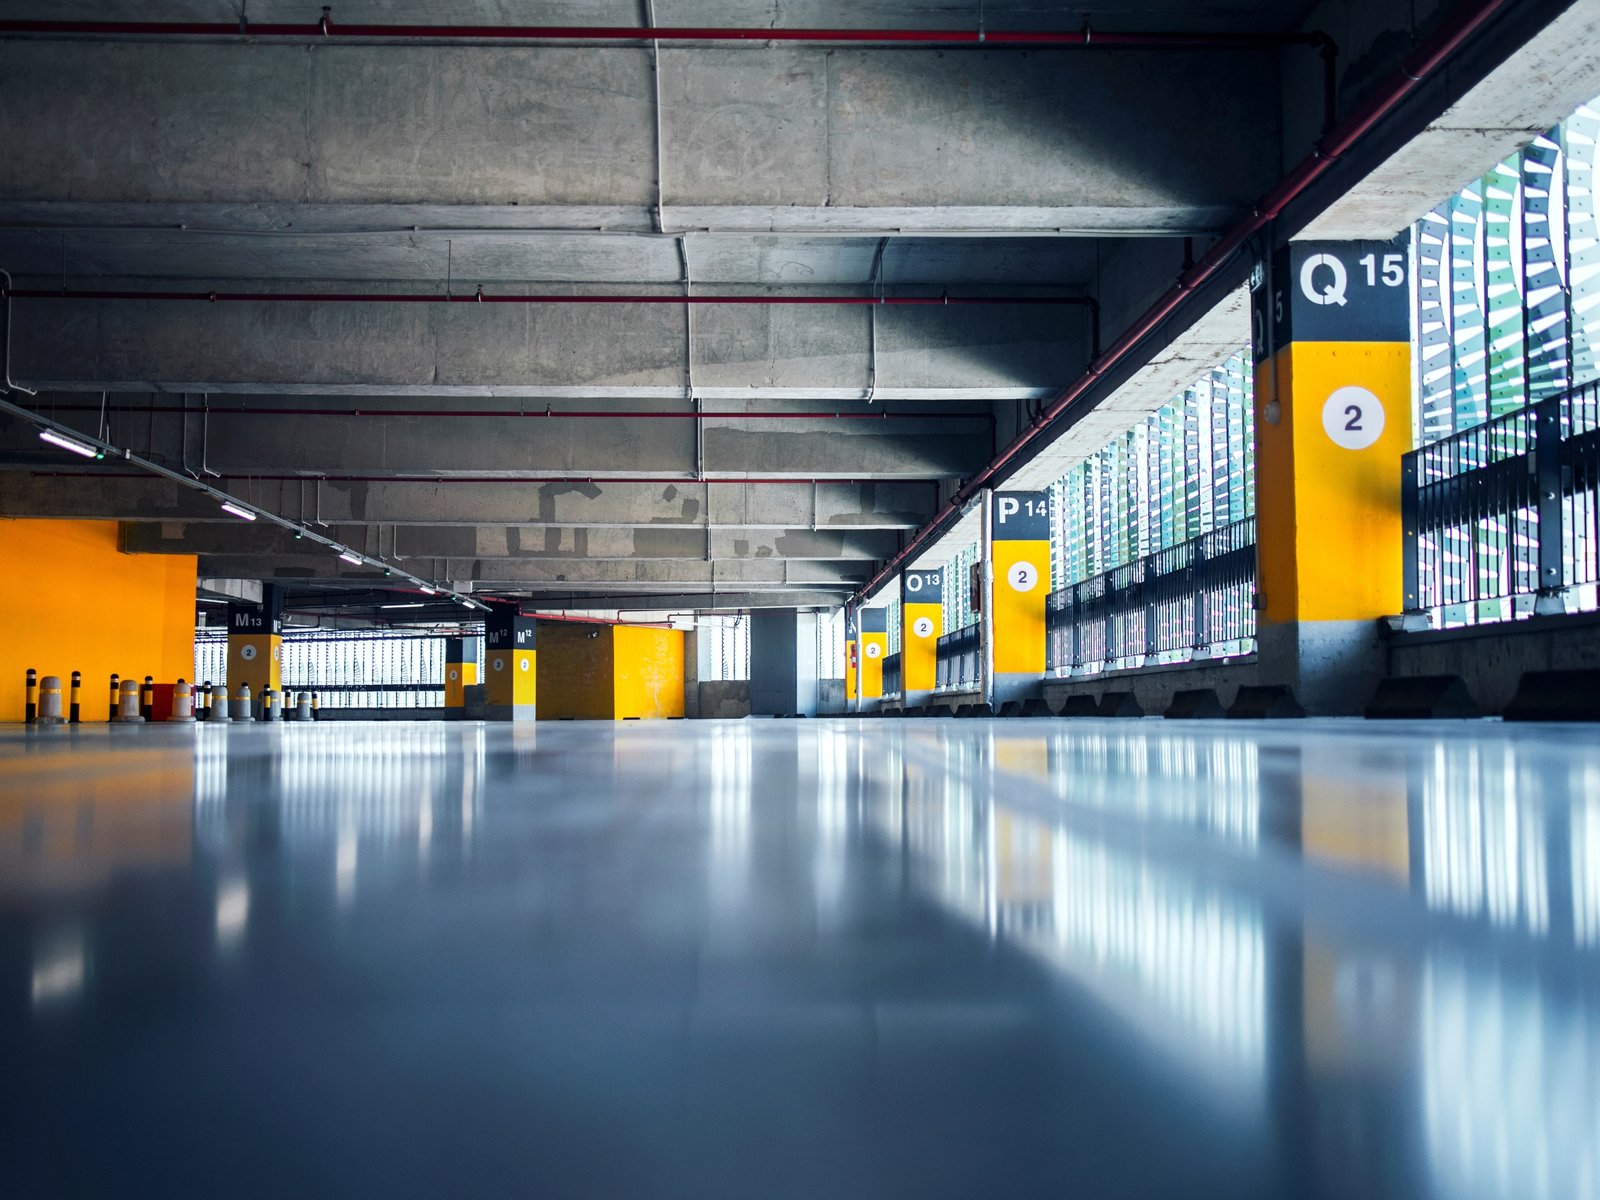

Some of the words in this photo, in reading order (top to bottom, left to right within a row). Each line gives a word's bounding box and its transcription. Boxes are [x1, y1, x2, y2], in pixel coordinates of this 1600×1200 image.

[1300, 253, 1348, 306] Q
[1359, 254, 1404, 287] 15
[1344, 405, 1362, 431] 2
[999, 497, 1019, 523] P
[1025, 501, 1047, 516] 14
[906, 574, 923, 591] O
[925, 575, 940, 585] 13
[1018, 570, 1027, 583] 2
[235, 613, 249, 626] M
[250, 618, 262, 626] 13
[920, 624, 927, 632] 2
[489, 632, 499, 643] M
[517, 631, 525, 643] M
[525, 629, 532, 637] 12
